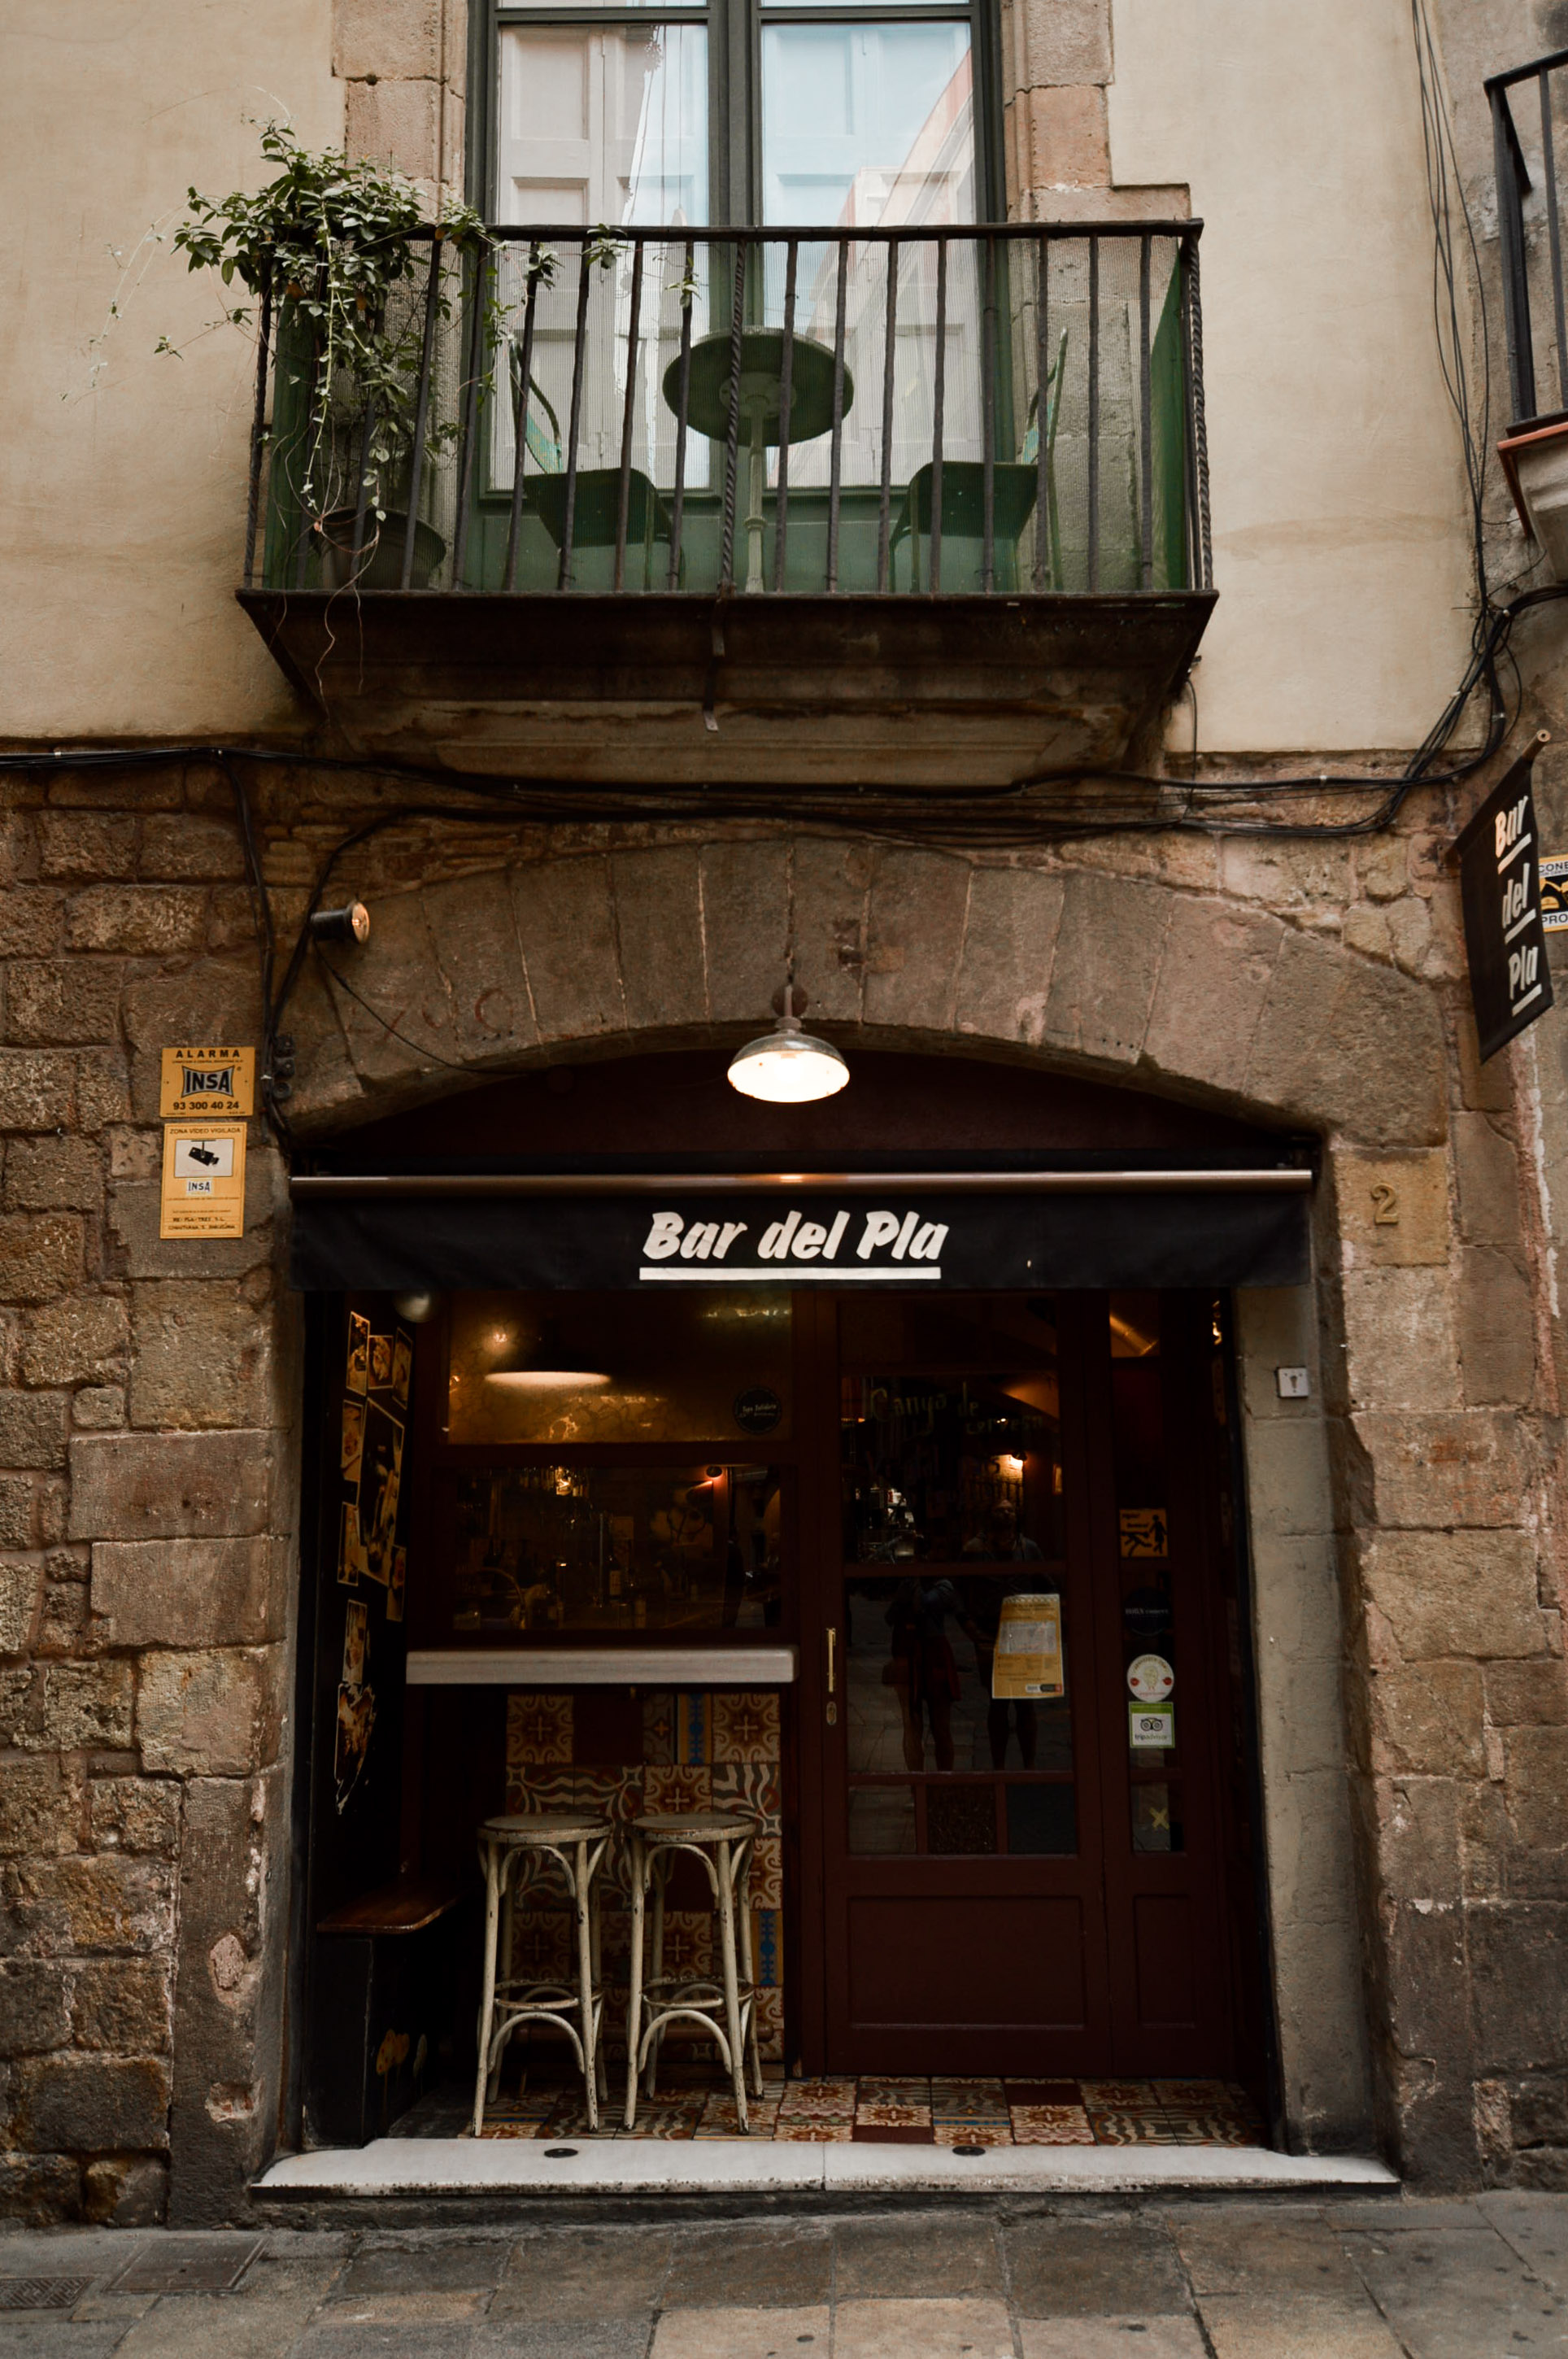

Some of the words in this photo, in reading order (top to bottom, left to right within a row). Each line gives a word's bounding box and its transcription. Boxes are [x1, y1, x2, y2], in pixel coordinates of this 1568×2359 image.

[1495, 796, 1529, 858] Bar
[1502, 862, 1531, 929] del
[1509, 945, 1539, 1000] Pla
[176, 1049, 240, 1058] ALARMA
[186, 1070, 230, 1093] INSA
[173, 1102, 186, 1110] 93
[189, 1101, 208, 1110] 300
[211, 1101, 224, 1110] 40
[226, 1101, 239, 1110] 24
[188, 1181, 211, 1192] INSA
[1370, 1183, 1399, 1225] 2
[642, 1210, 748, 1260] Bar
[756, 1210, 851, 1260] del
[856, 1210, 950, 1261] Pla
